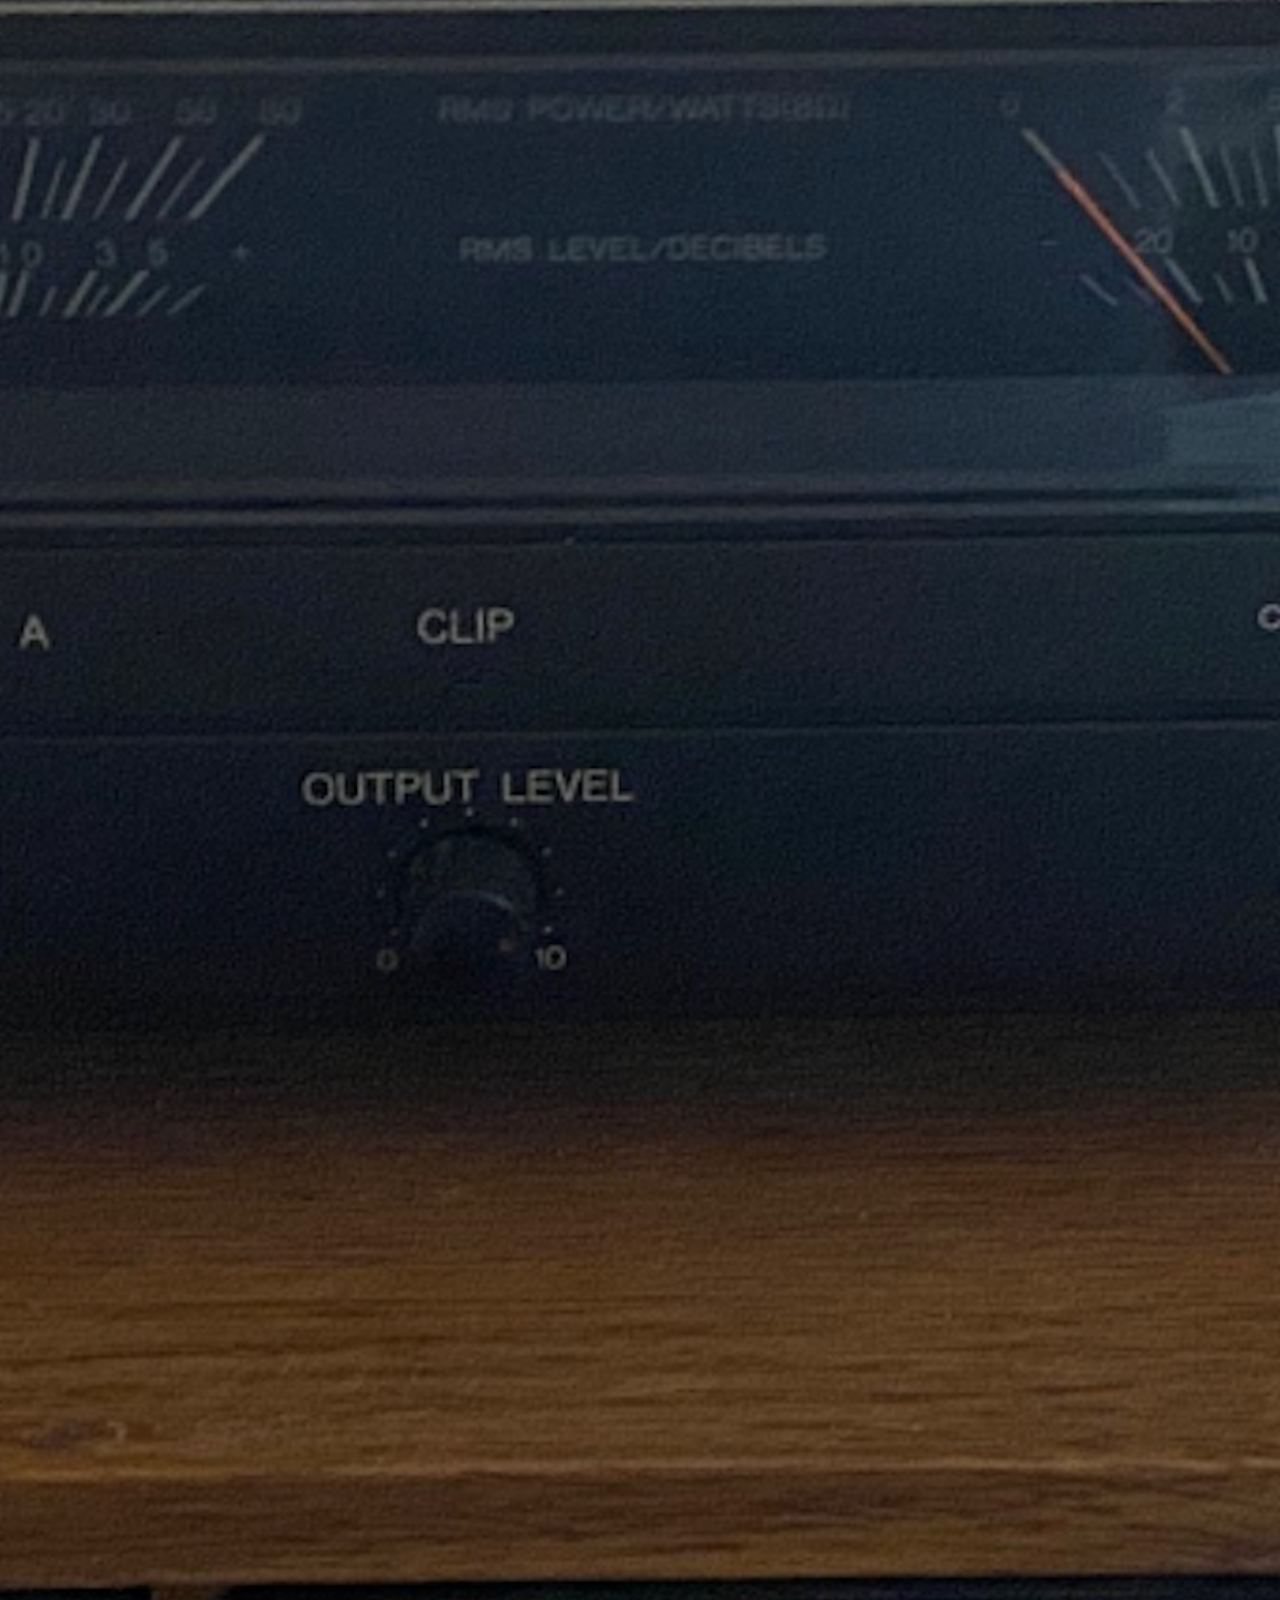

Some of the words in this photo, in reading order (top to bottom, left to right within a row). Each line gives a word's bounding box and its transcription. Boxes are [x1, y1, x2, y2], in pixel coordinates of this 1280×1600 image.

[23, 98, 65, 126] 20
[1165, 87, 1185, 115] 2
[97, 241, 117, 267] 3
[147, 241, 169, 267] 5
[459, 236, 532, 263] RMS
[548, 234, 828, 263] LEVEL/DECIBELS
[1139, 227, 1174, 255] 20
[1228, 227, 1259, 254] 10
[18, 614, 50, 651] A
[416, 608, 515, 646] CLIP
[302, 771, 478, 808] OUTPUT
[503, 768, 633, 805] LEVEL
[375, 947, 399, 973] 0
[534, 943, 568, 971] 10
